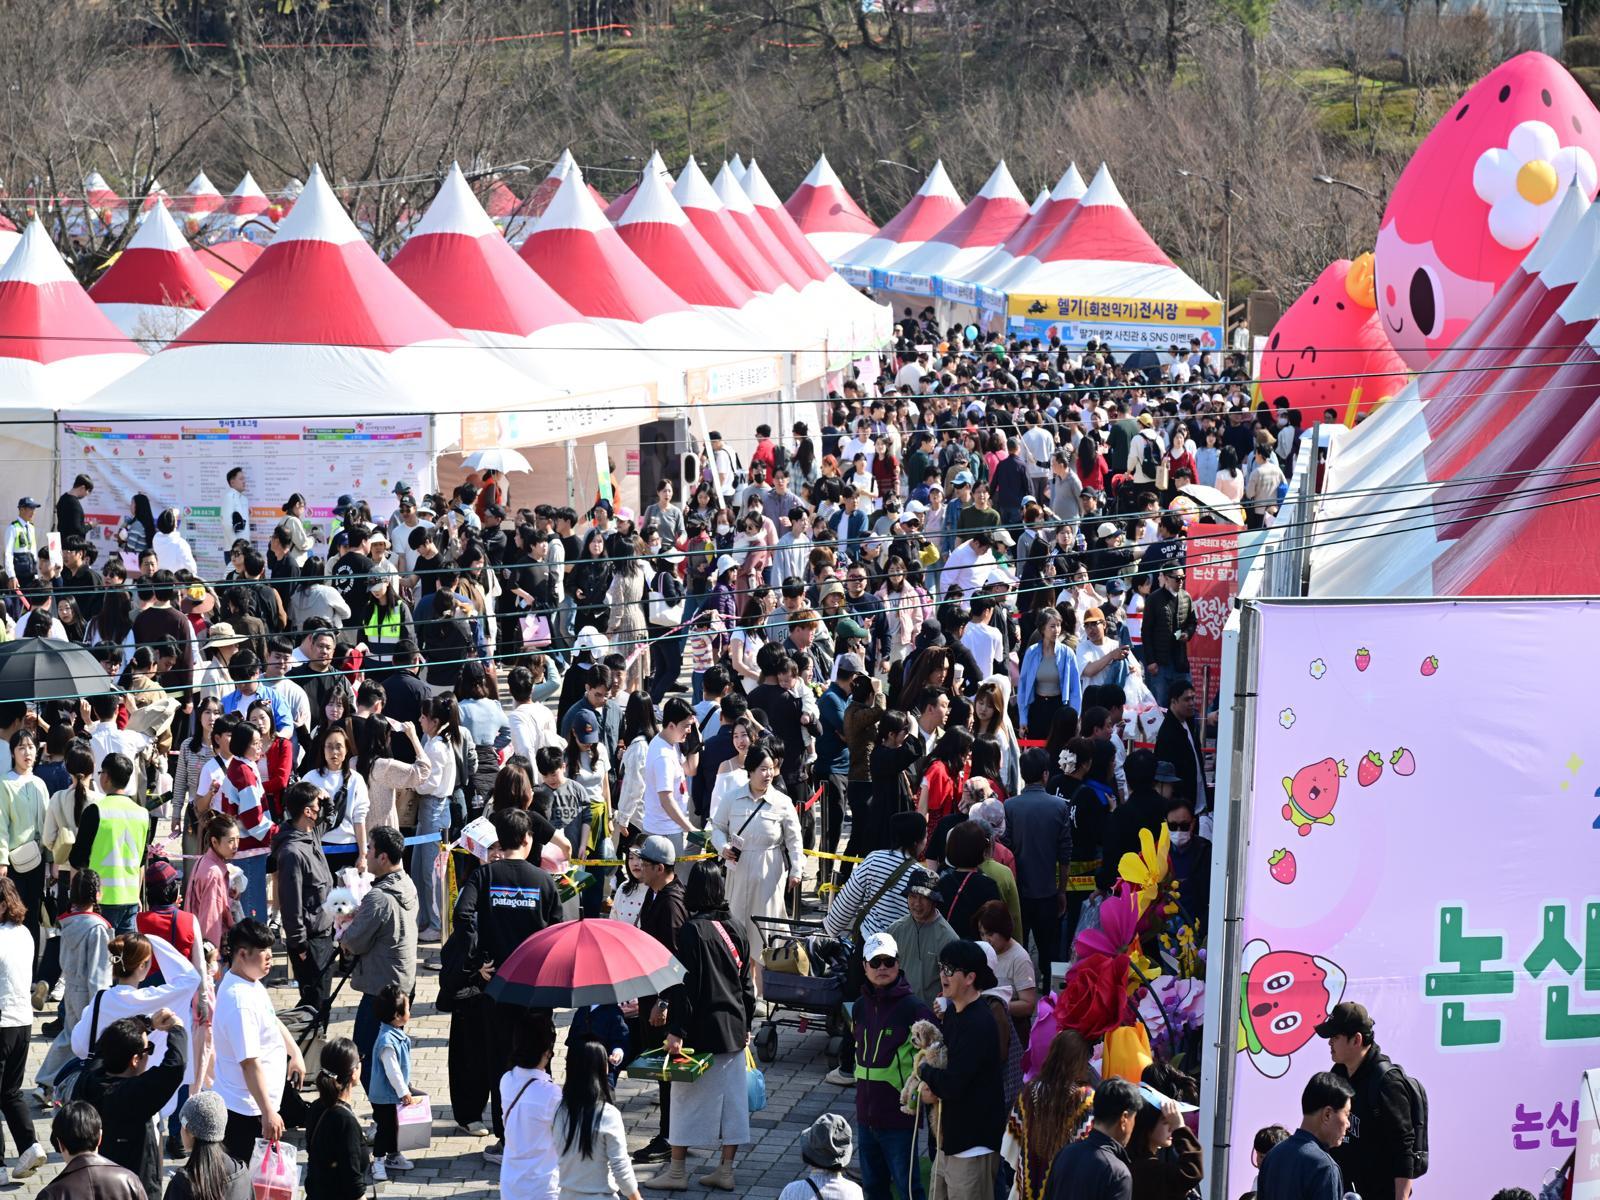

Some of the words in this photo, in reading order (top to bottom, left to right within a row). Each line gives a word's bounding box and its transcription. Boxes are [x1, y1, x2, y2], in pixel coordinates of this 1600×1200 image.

[1114, 330, 1139, 342] 사진관
[1140, 332, 1148, 342] &
[1149, 332, 1169, 343] SNS
[1170, 333, 1195, 344] 이벤트
[1193, 567, 1215, 580] 논산
[1217, 568, 1238, 581] 딸기
[492, 897, 537, 908] patagonia
